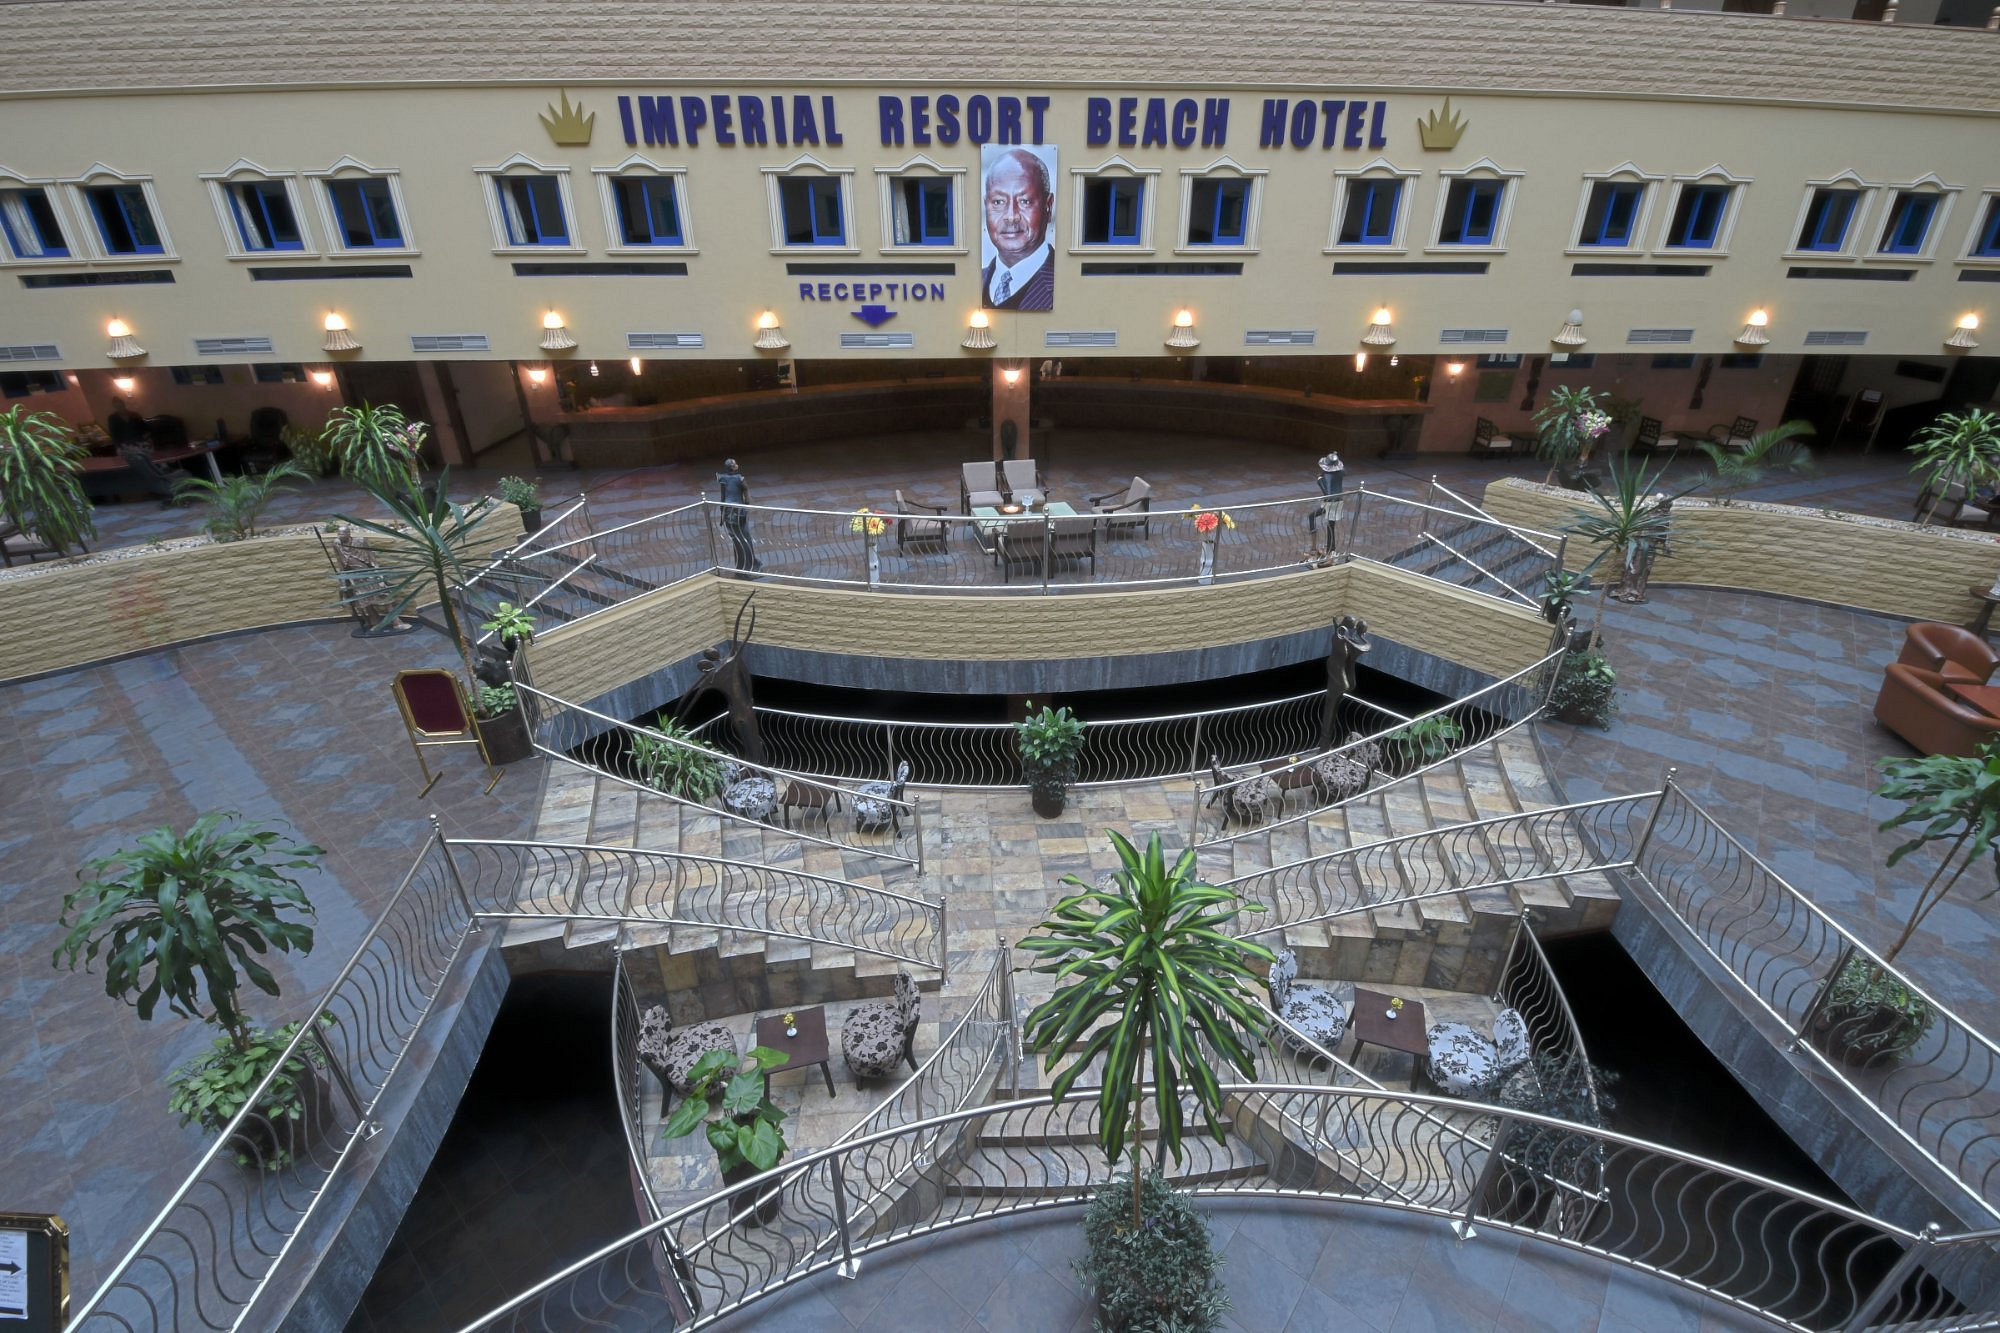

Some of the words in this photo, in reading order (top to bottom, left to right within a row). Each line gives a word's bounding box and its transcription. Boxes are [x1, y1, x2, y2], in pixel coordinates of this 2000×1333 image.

[618, 95, 844, 146] IMPERIAL
[879, 95, 1051, 145] RESORT
[1086, 97, 1230, 147] BEACH
[1260, 99, 1388, 148] HOTEL
[799, 282, 946, 301] RECEPTION
